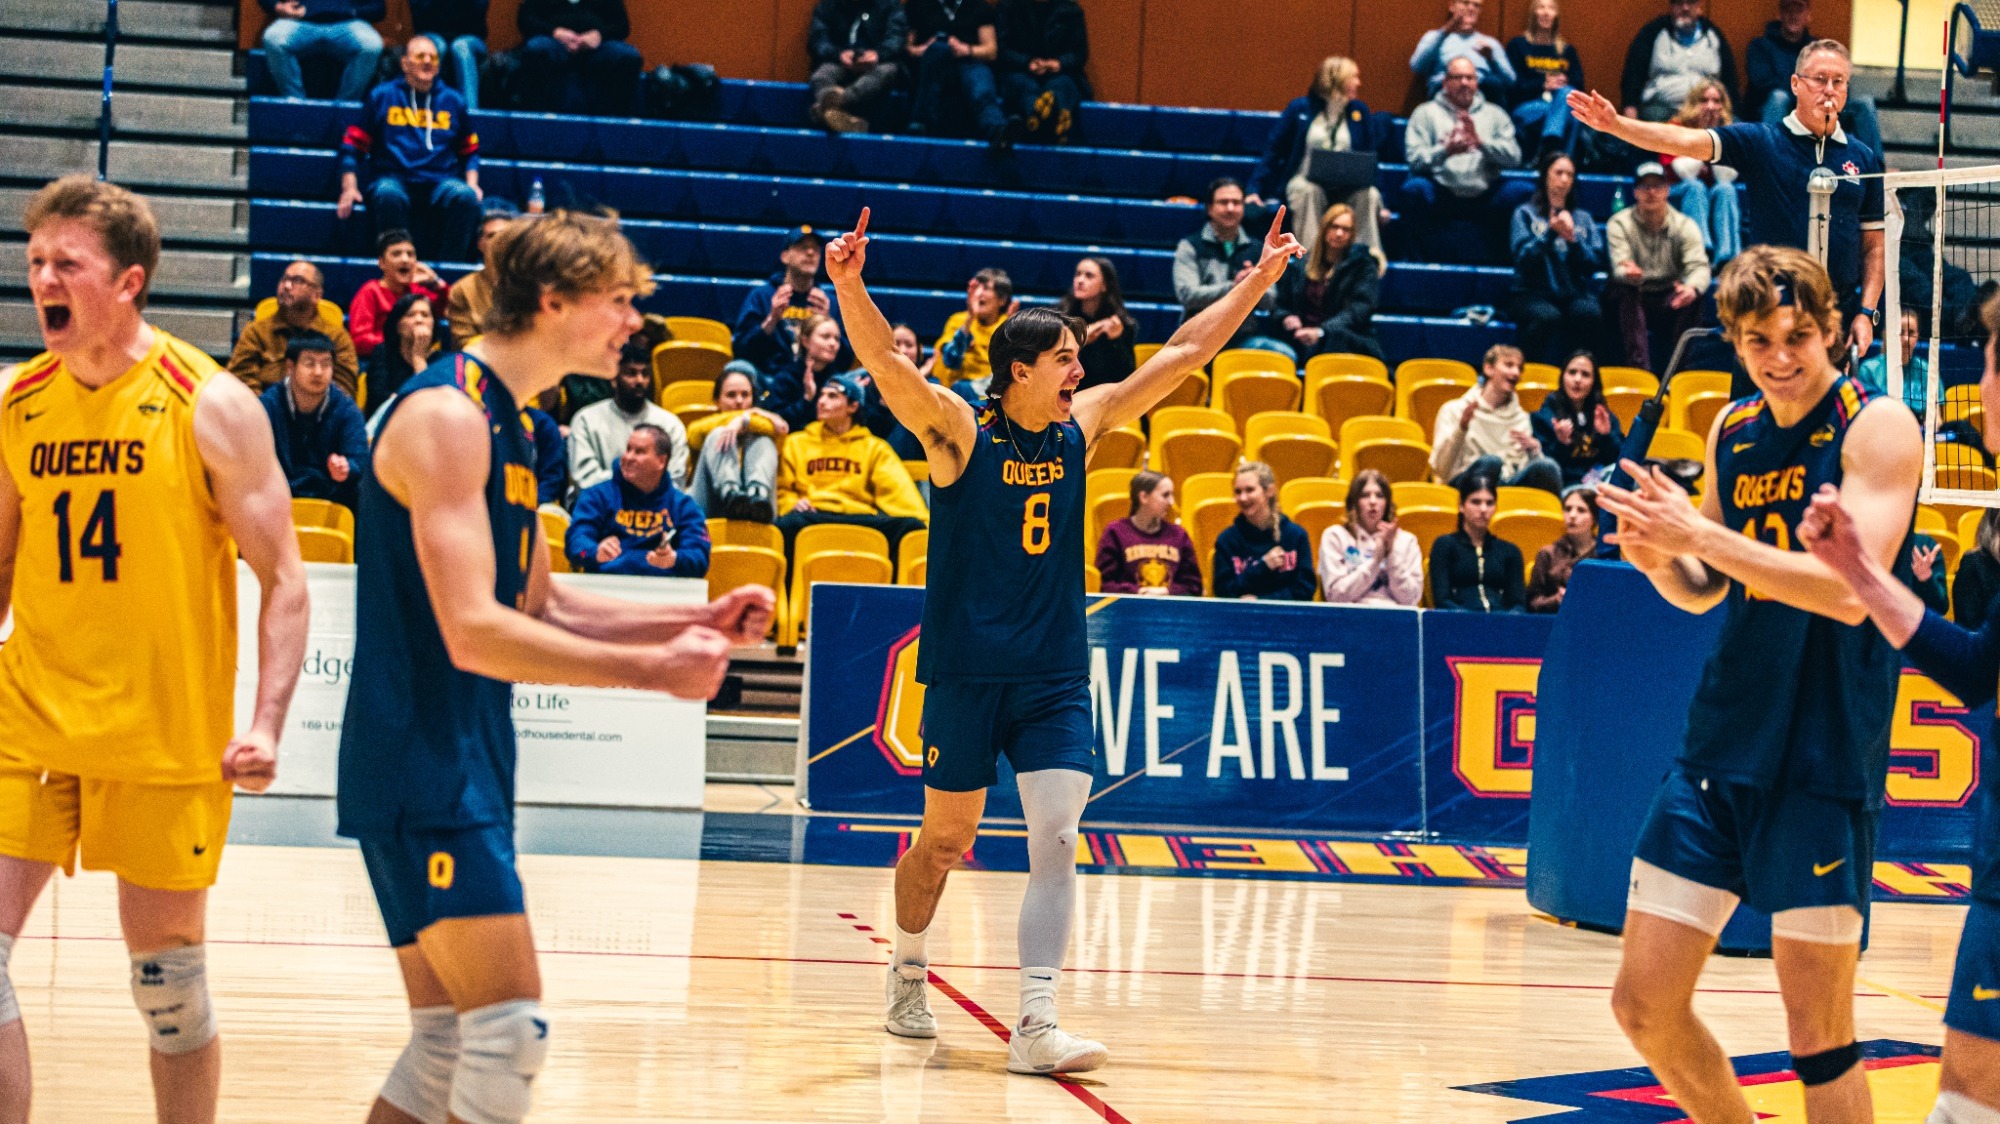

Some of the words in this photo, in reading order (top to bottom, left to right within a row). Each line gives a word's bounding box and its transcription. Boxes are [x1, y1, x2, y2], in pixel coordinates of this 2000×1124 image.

[30, 440, 146, 478] QUEEN'S
[53, 489, 122, 583] 14
[1022, 492, 1051, 555] 8
[537, 693, 570, 710] Life
[1206, 650, 1349, 781] ARE
[515, 730, 622, 742] odhousedental.com
